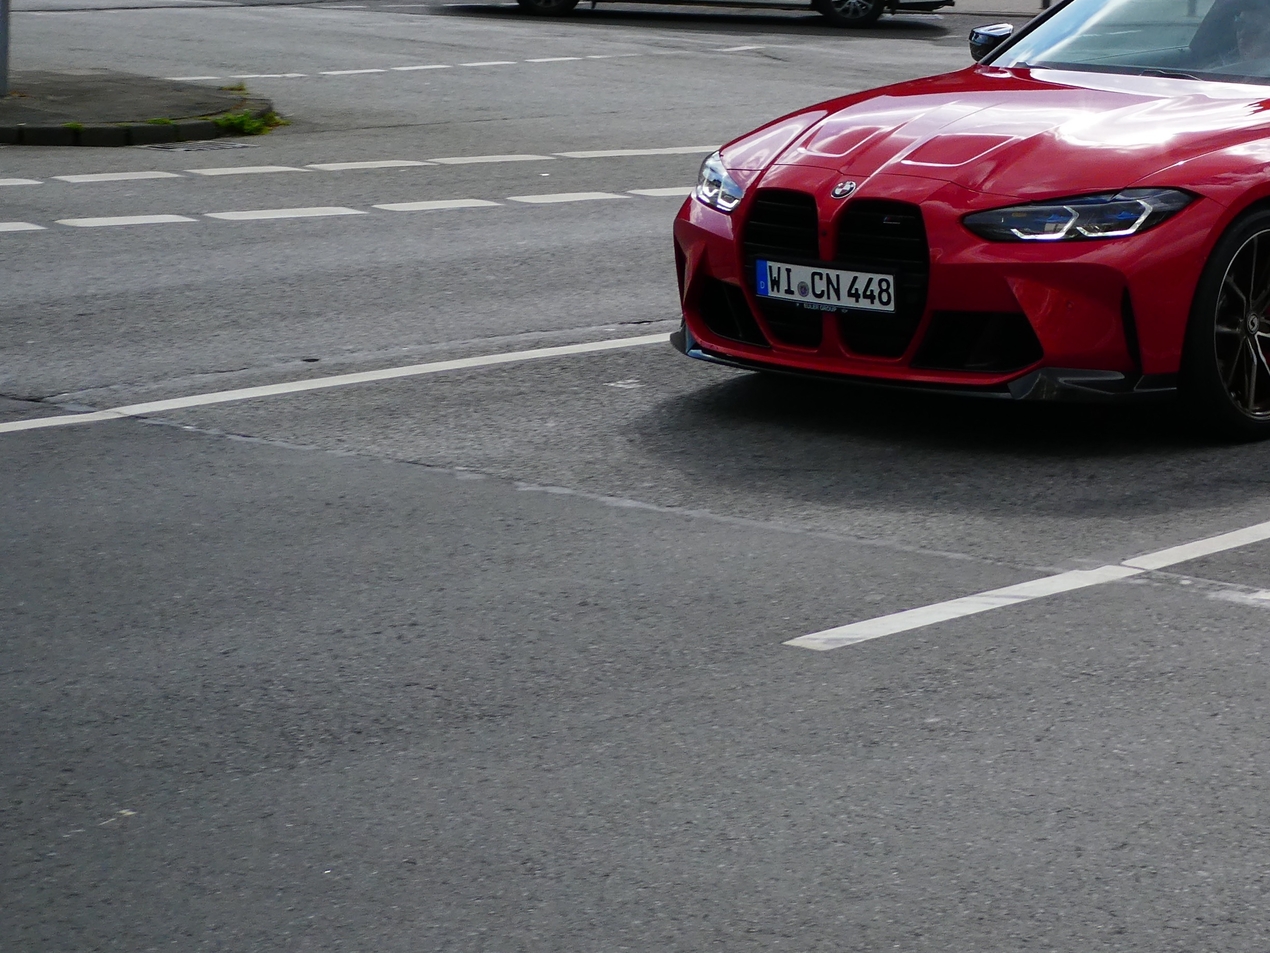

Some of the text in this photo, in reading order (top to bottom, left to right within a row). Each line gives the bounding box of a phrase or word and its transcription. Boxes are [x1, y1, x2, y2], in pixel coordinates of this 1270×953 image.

[768, 265, 892, 307] WI CN 448
